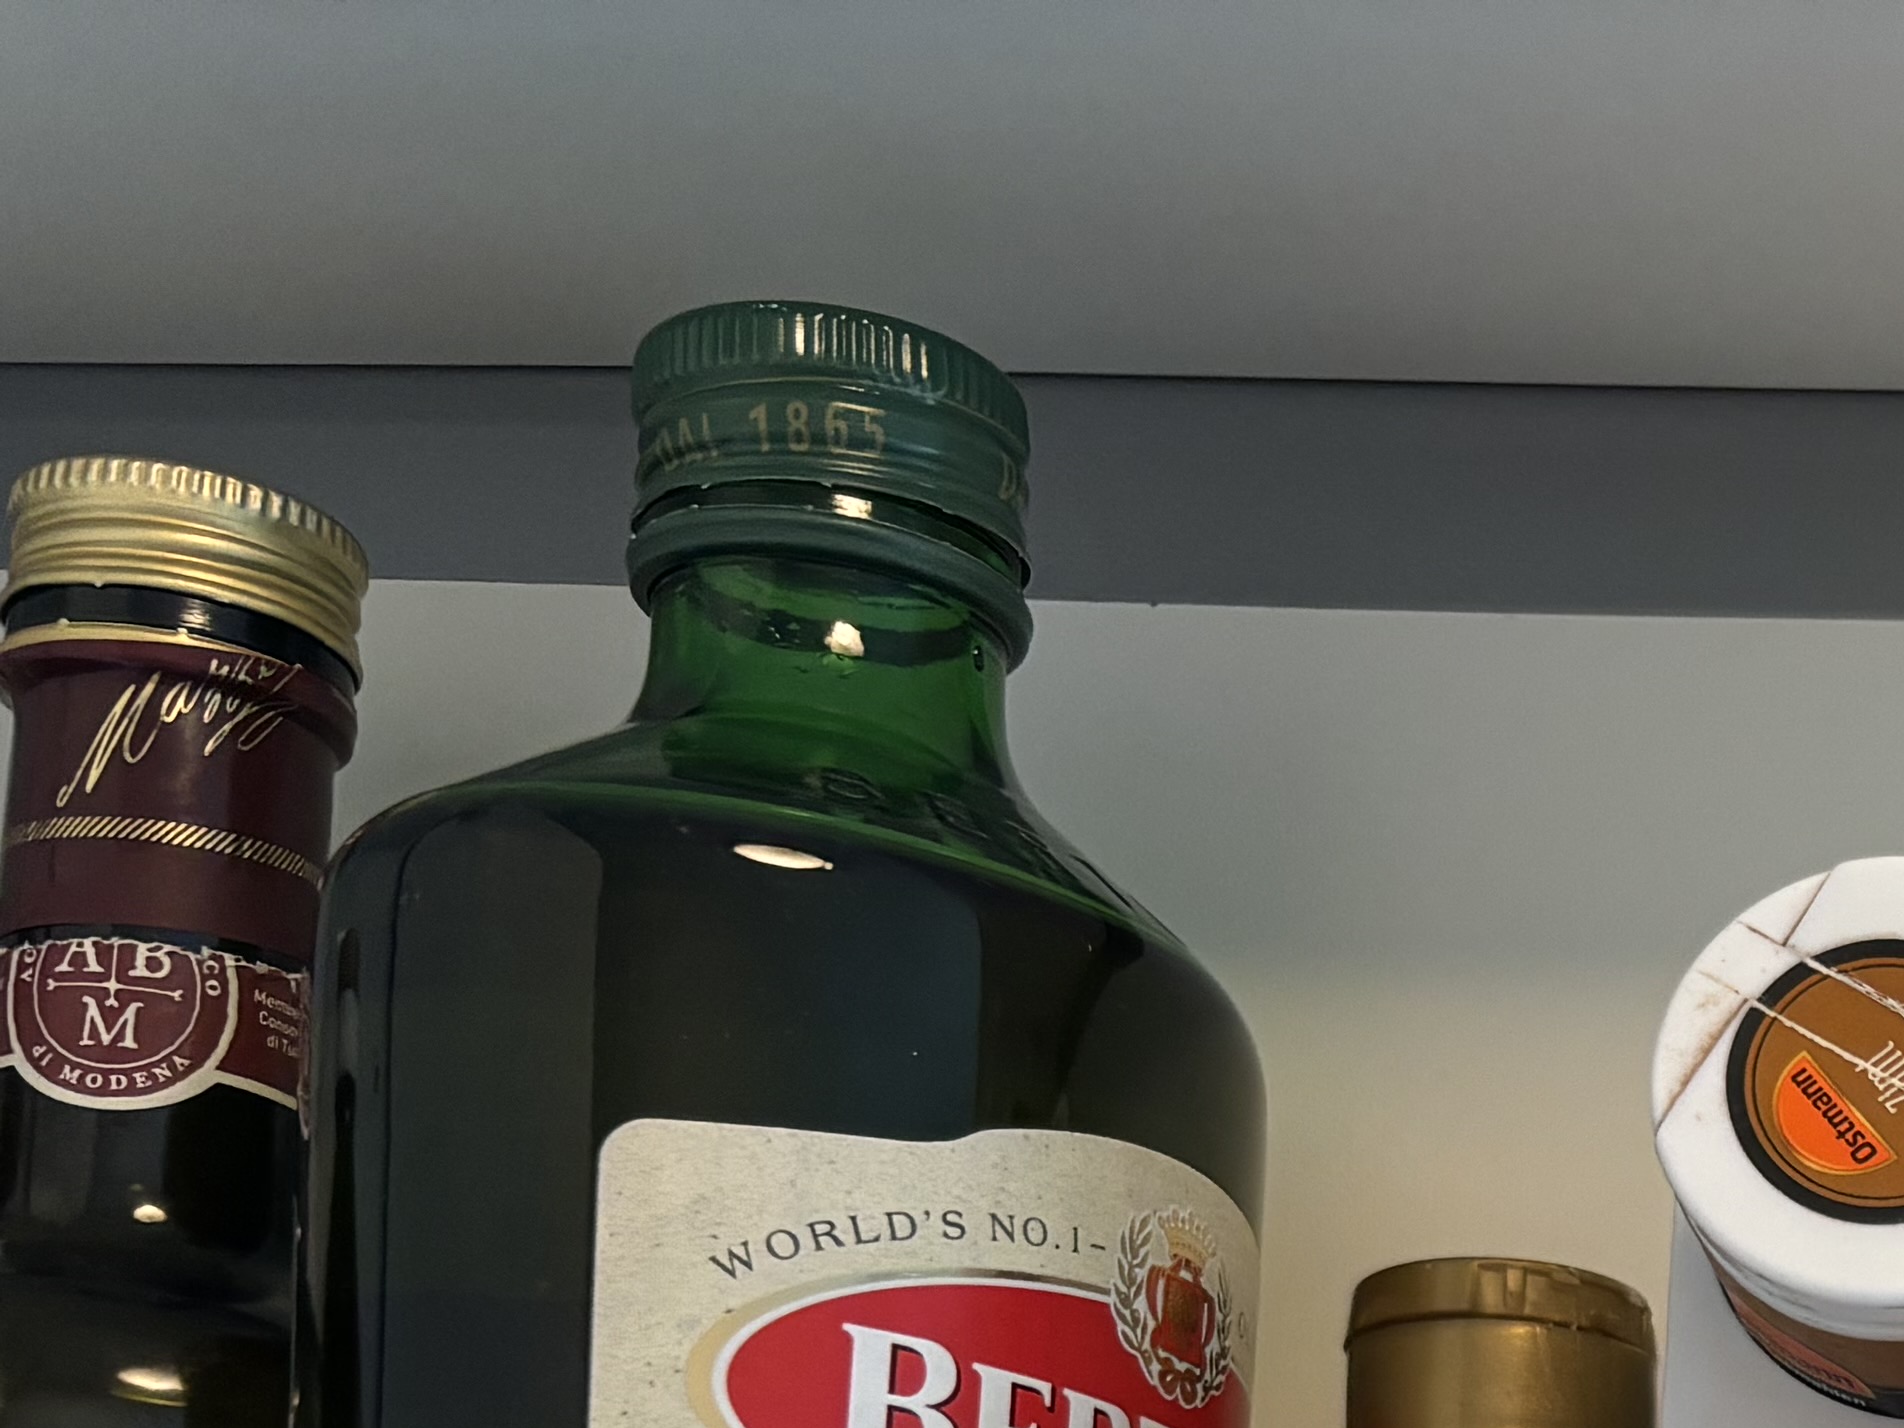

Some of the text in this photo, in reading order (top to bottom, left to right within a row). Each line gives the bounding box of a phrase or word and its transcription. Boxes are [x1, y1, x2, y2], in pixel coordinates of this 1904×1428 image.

[749, 402, 886, 458] 1865
[59, 1056, 191, 1091] MODENA
[1791, 1067, 1877, 1165] Ostmann
